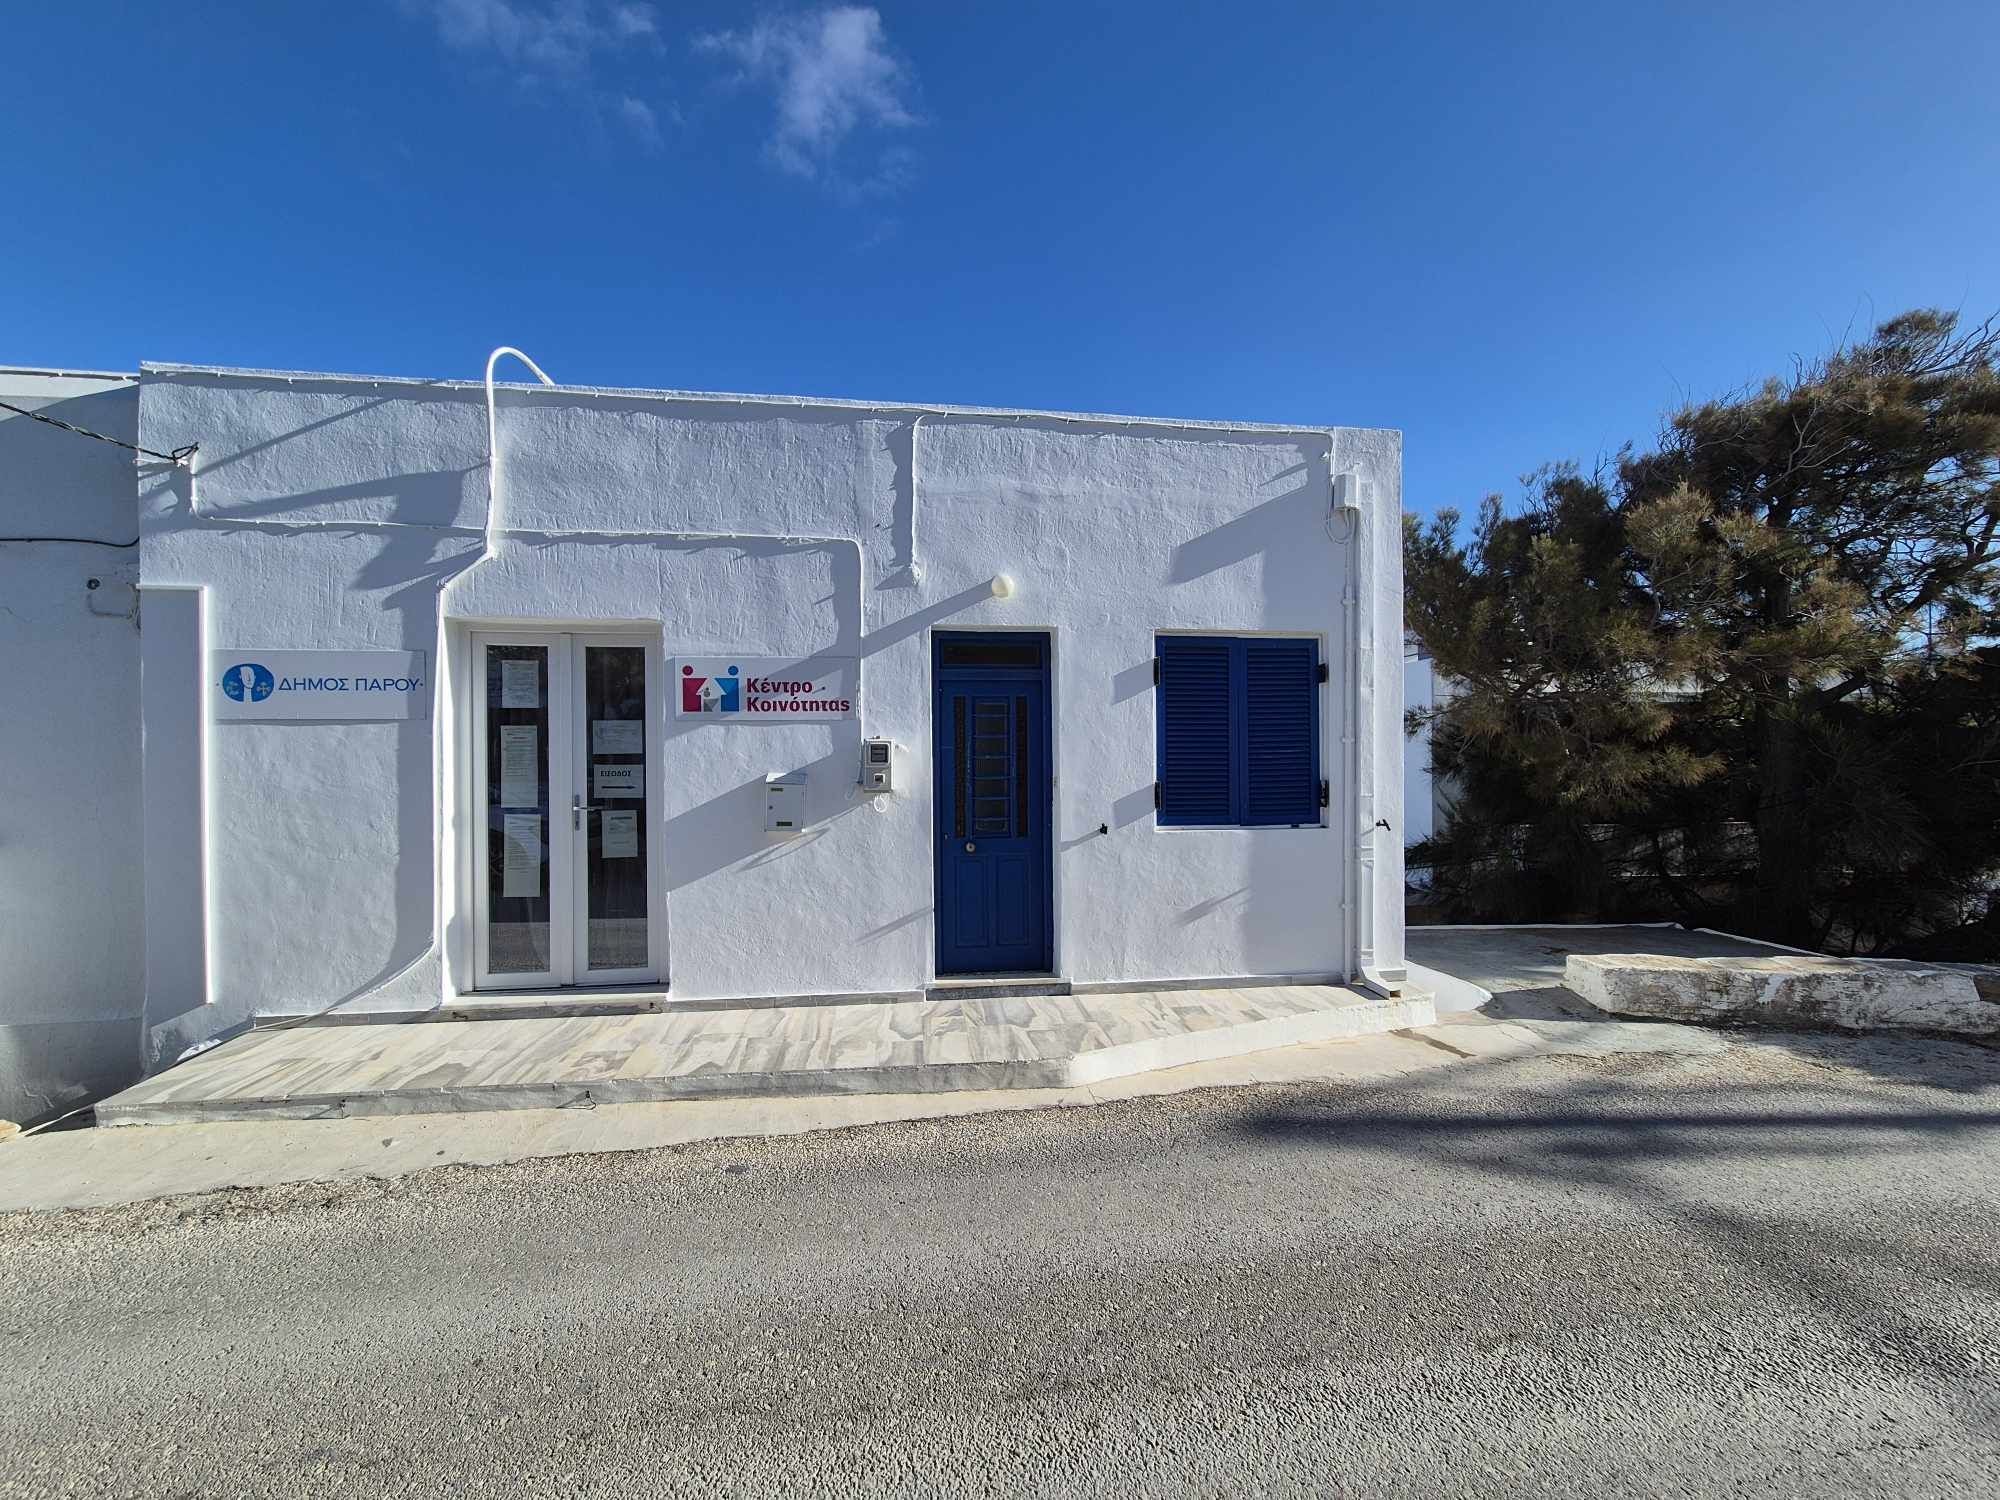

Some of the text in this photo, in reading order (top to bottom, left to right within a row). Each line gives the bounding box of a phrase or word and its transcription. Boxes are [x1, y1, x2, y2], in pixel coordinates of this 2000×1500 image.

[278, 678, 419, 691] ΔΗΜΟΣ ΠΑΡΟΥ
[747, 677, 813, 696] Κέντρο
[747, 697, 850, 712] Κοινότητας
